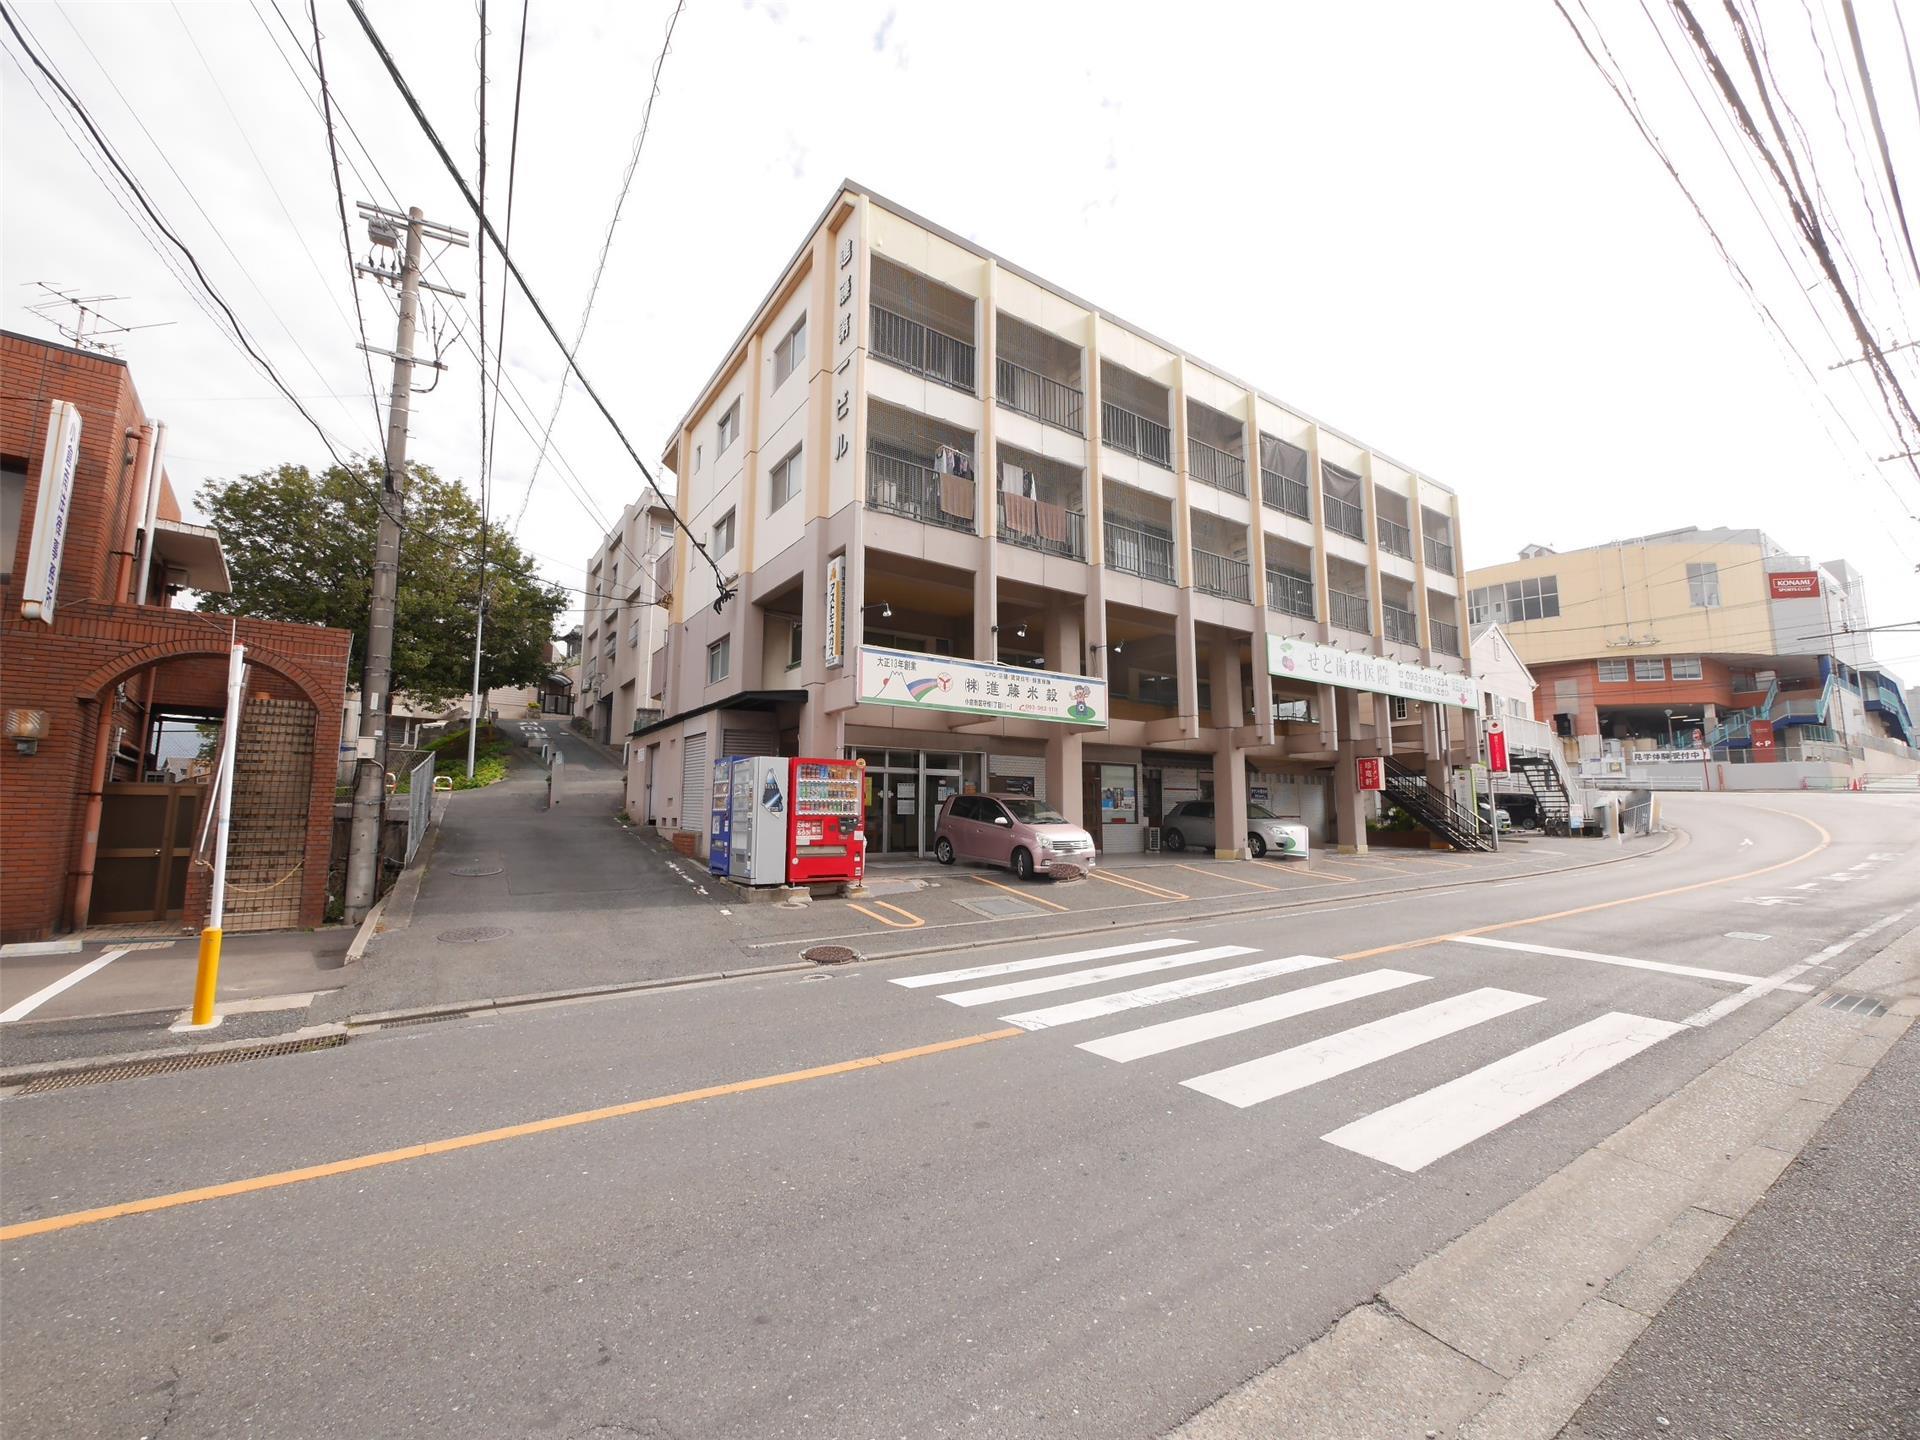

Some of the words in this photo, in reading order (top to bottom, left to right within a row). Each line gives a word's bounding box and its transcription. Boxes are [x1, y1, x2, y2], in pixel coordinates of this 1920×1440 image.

[876, 656, 918, 672] 大正13年創業
[1307, 652, 1390, 686] せと歯科医院
[1634, 750, 1700, 761] 見学体験受付中
